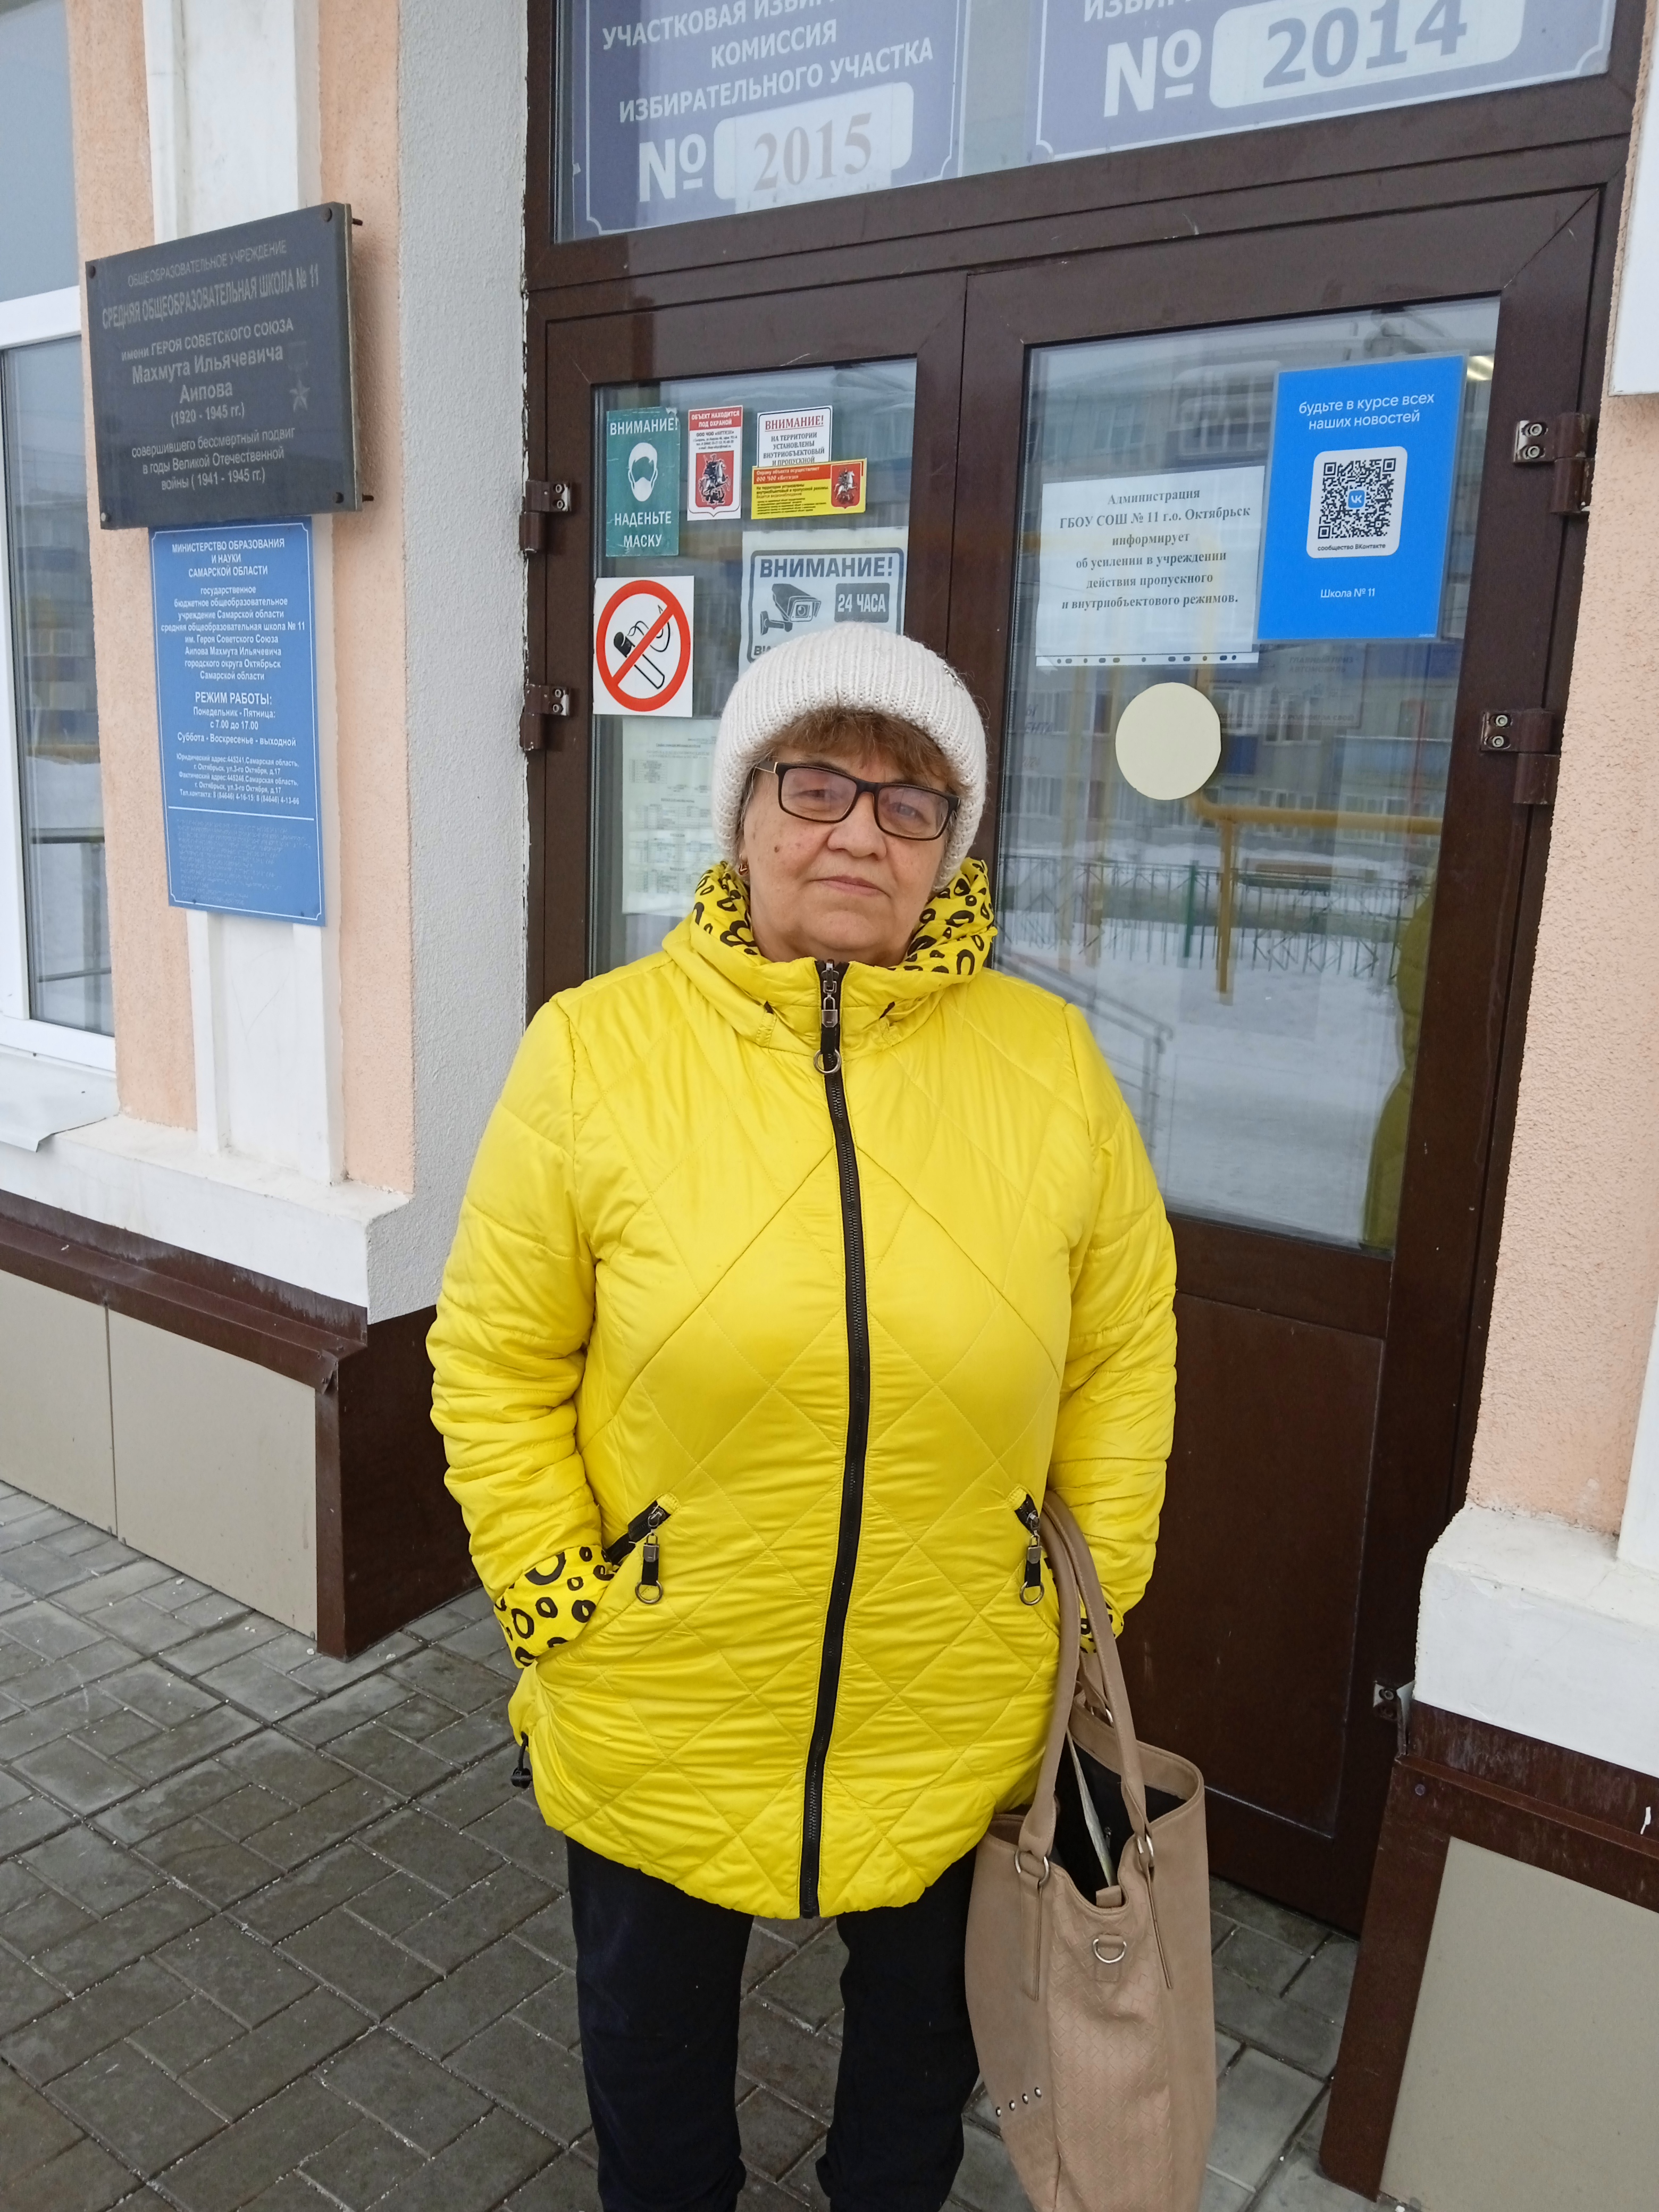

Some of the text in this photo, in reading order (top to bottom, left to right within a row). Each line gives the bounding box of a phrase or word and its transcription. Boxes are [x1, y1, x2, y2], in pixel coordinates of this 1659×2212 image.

[602, 0, 745, 49] УЧАСТКОВАЯ
[711, 19, 836, 69] КОМИССИЯ
[1104, 0, 1467, 117] № 2014
[619, 37, 933, 123] ИЗБИРАТЕЛЬНОГО УЧАСТКА
[639, 112, 871, 202] № 2015
[128, 240, 287, 287] ОБЩЕОБРАЗОВАТЕЛЬНОЕ УЧРЕЖДЕНИЕ
[103, 263, 318, 329] СРЕДНЯЯ ОБЩЕОБРАЗОВАТЕЛЬНАЯ ШКОЛА № 11
[152, 338, 182, 355] ГЕРОЯ
[185, 325, 251, 349] СОВЕТСКОГО
[254, 317, 294, 337] СОЮЗА
[132, 345, 283, 384] Махмута Ильячевича
[180, 382, 232, 404] Аипова
[1298, 393, 1435, 416] будьте в курсе всех
[171, 409, 196, 428] (1920
[205, 404, 228, 420] 1945
[765, 415, 824, 430] ВНИМАНИЕ!
[1309, 409, 1420, 430] наших новостей
[610, 418, 677, 435] ВНИМАНИЕ!
[132, 428, 295, 458] совершившего бессмертный подвиг
[780, 432, 817, 441] ТЕРРИТОРИИ
[773, 440, 814, 450] УСТАНОВЛЕНЫ
[143, 445, 284, 475] в годы Великой Отечественной
[764, 447, 824, 459] ВНУТРИОБЪЕКТОВЫЙ
[778, 456, 815, 466] ПРОПУСКНОЙ
[162, 476, 189, 490] войны
[197, 472, 217, 485] 1941
[228, 468, 249, 482] 1945
[1108, 490, 1200, 505] Администрация
[615, 511, 672, 527] НАДЕНЬТЕ
[1060, 507, 1251, 529] ГБОУ СОШ № 11 г.о. Октябрьск
[172, 538, 284, 553] МИНИСТЕРСТВО ОБРАЗОВАНИЯ
[624, 534, 662, 547] МАСКУ
[1112, 533, 1190, 548] информирует
[212, 553, 241, 564] И НАУКИ
[1076, 558, 1088, 568] об
[1091, 557, 1143, 570] усилении
[1157, 552, 1226, 567] учреждении
[189, 565, 268, 577] САМАРСКОЙ ОБЛАСТИ
[760, 557, 892, 577] ВНИМАНИЕ!
[1086, 574, 1213, 589] действия пропускного
[200, 586, 256, 596] государственное
[1320, 588, 1375, 598] Школа № 11
[174, 597, 288, 608] бюджетное общеобразовательное
[838, 593, 886, 613] 24 ЧАСА
[1071, 597, 1179, 611] внутриобъектового
[1183, 594, 1238, 607] режимов.
[178, 609, 284, 621] учреждение Самарской области
[161, 624, 186, 633] средняя
[188, 622, 262, 632] общеобразовательная
[288, 622, 296, 630] №
[298, 621, 305, 630] 11
[197, 634, 215, 644] Героя
[216, 634, 254, 643] Советского
[256, 634, 278, 643] Союза
[185, 647, 281, 657] Аипова Махмута Ильячевича
[221, 660, 242, 669] округа
[244, 659, 281, 669] Октябрьск
[200, 671, 265, 681] Самарской области
[195, 692, 272, 705] РЕЖИМ РАБОТЫ:
[193, 706, 275, 719] Понедельник Пятница:
[215, 719, 229, 728] 7.00
[241, 720, 258, 730] 17.00
[178, 732, 296, 747] Суббота Воскресенье выходной
